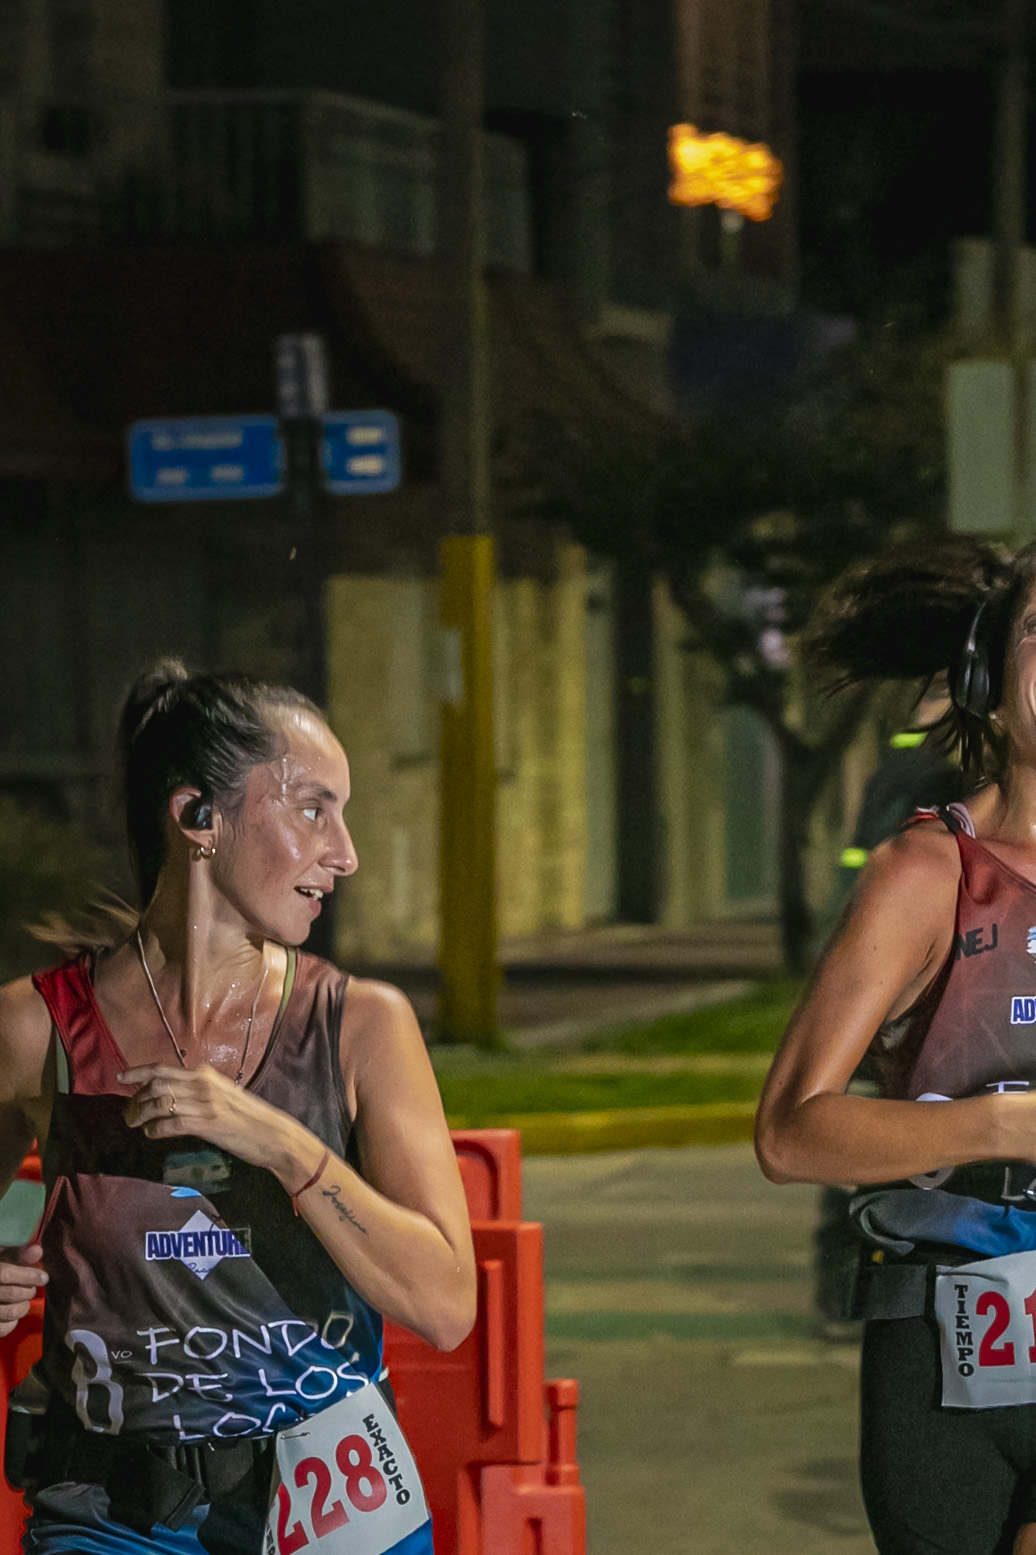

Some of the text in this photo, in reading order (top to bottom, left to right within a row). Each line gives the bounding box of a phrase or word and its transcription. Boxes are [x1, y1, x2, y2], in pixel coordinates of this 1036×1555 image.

[136, 1311, 354, 1365] FONDO
[954, 1284, 975, 1377] TIEMPO
[134, 1351, 369, 1403] DE LOS
[362, 1413, 411, 1506] EXACTO
